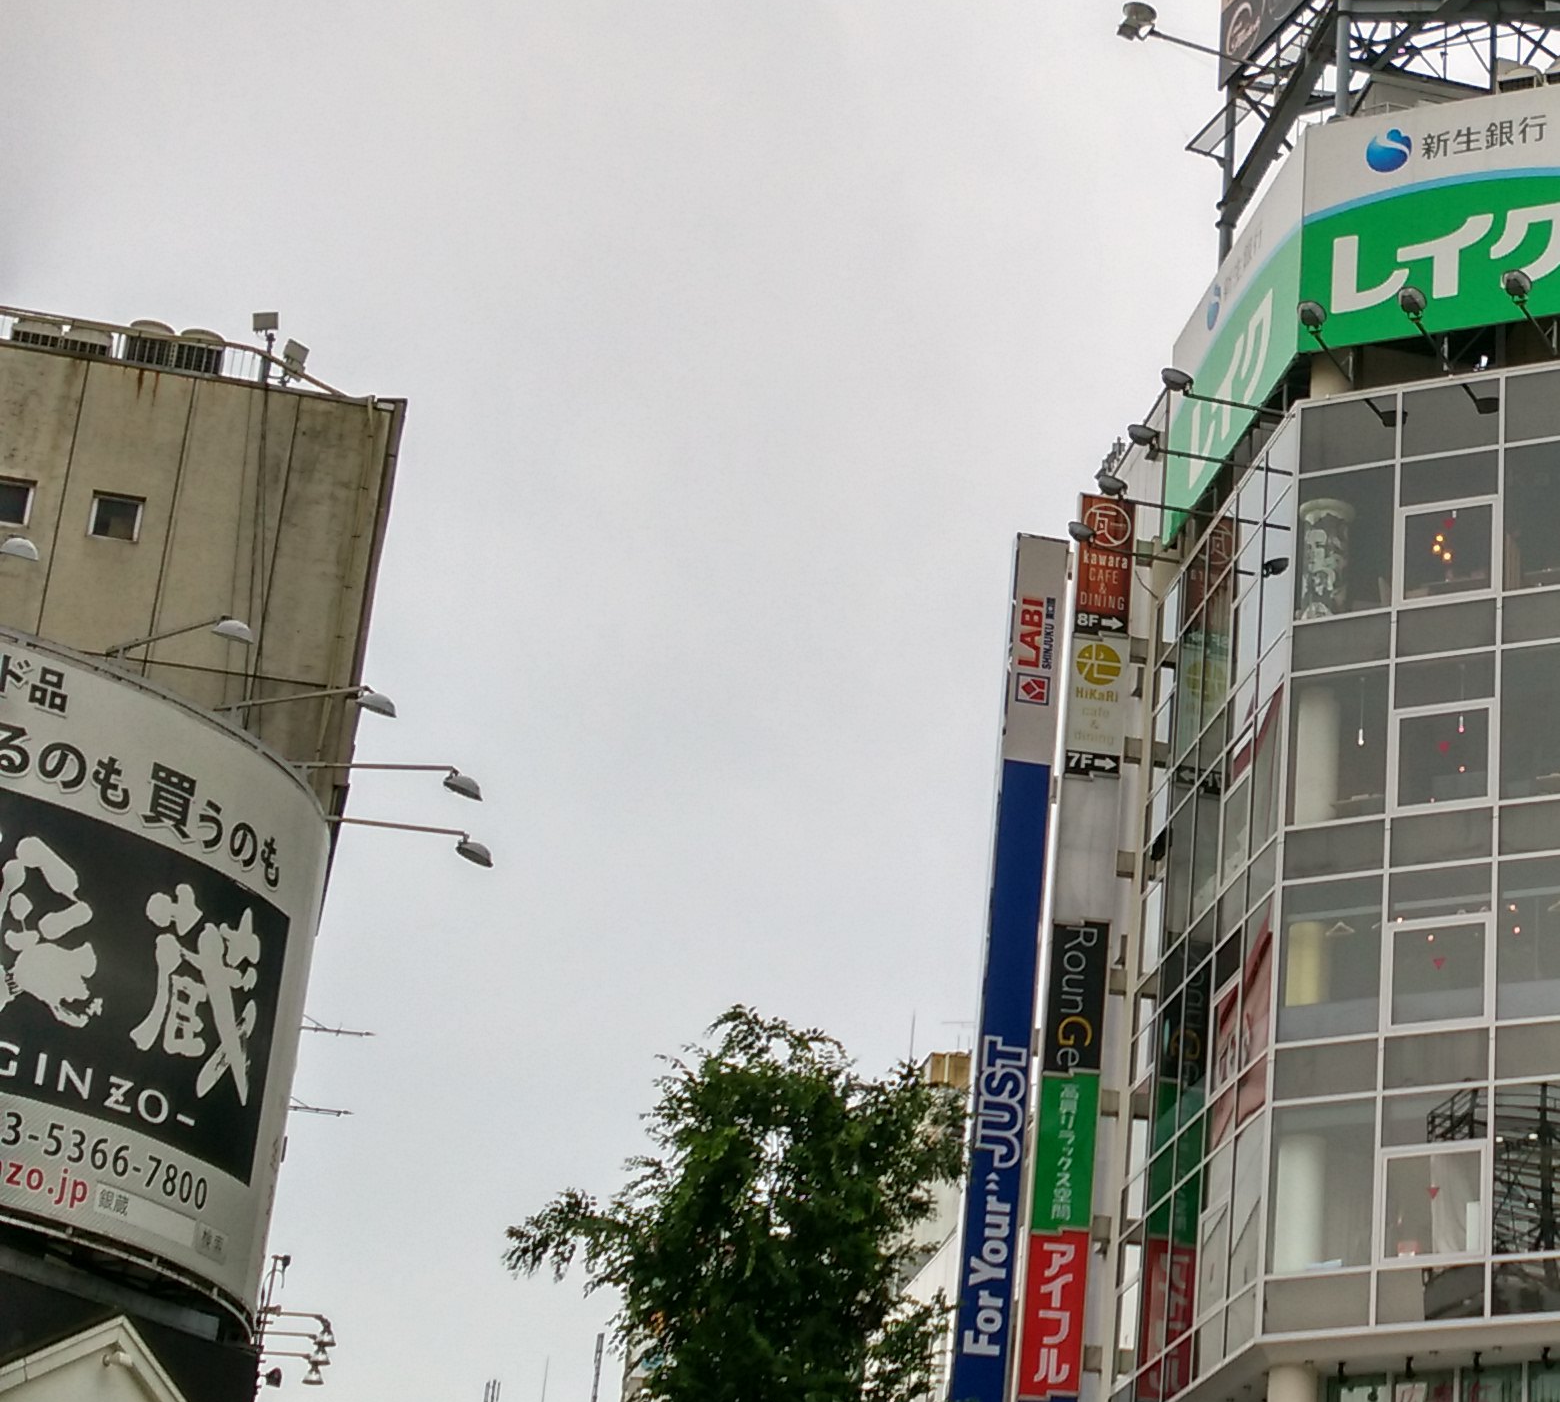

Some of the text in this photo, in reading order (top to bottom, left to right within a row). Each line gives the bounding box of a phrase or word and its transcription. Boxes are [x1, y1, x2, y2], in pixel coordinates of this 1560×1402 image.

[1421, 113, 1549, 160] 新生銀行
[1083, 550, 1129, 569] kawara
[1088, 567, 1119, 585] CAFE
[1077, 612, 1099, 628] 8F
[1080, 591, 1126, 611] DINING
[1017, 598, 1045, 669] LABI
[1067, 752, 1094, 771] 7F
[1056, 925, 1098, 1070] RounGe
[974, 1034, 1029, 1171] JUST
[962, 1188, 1014, 1358] For Your
[1034, 1241, 1075, 1386] アイフル
